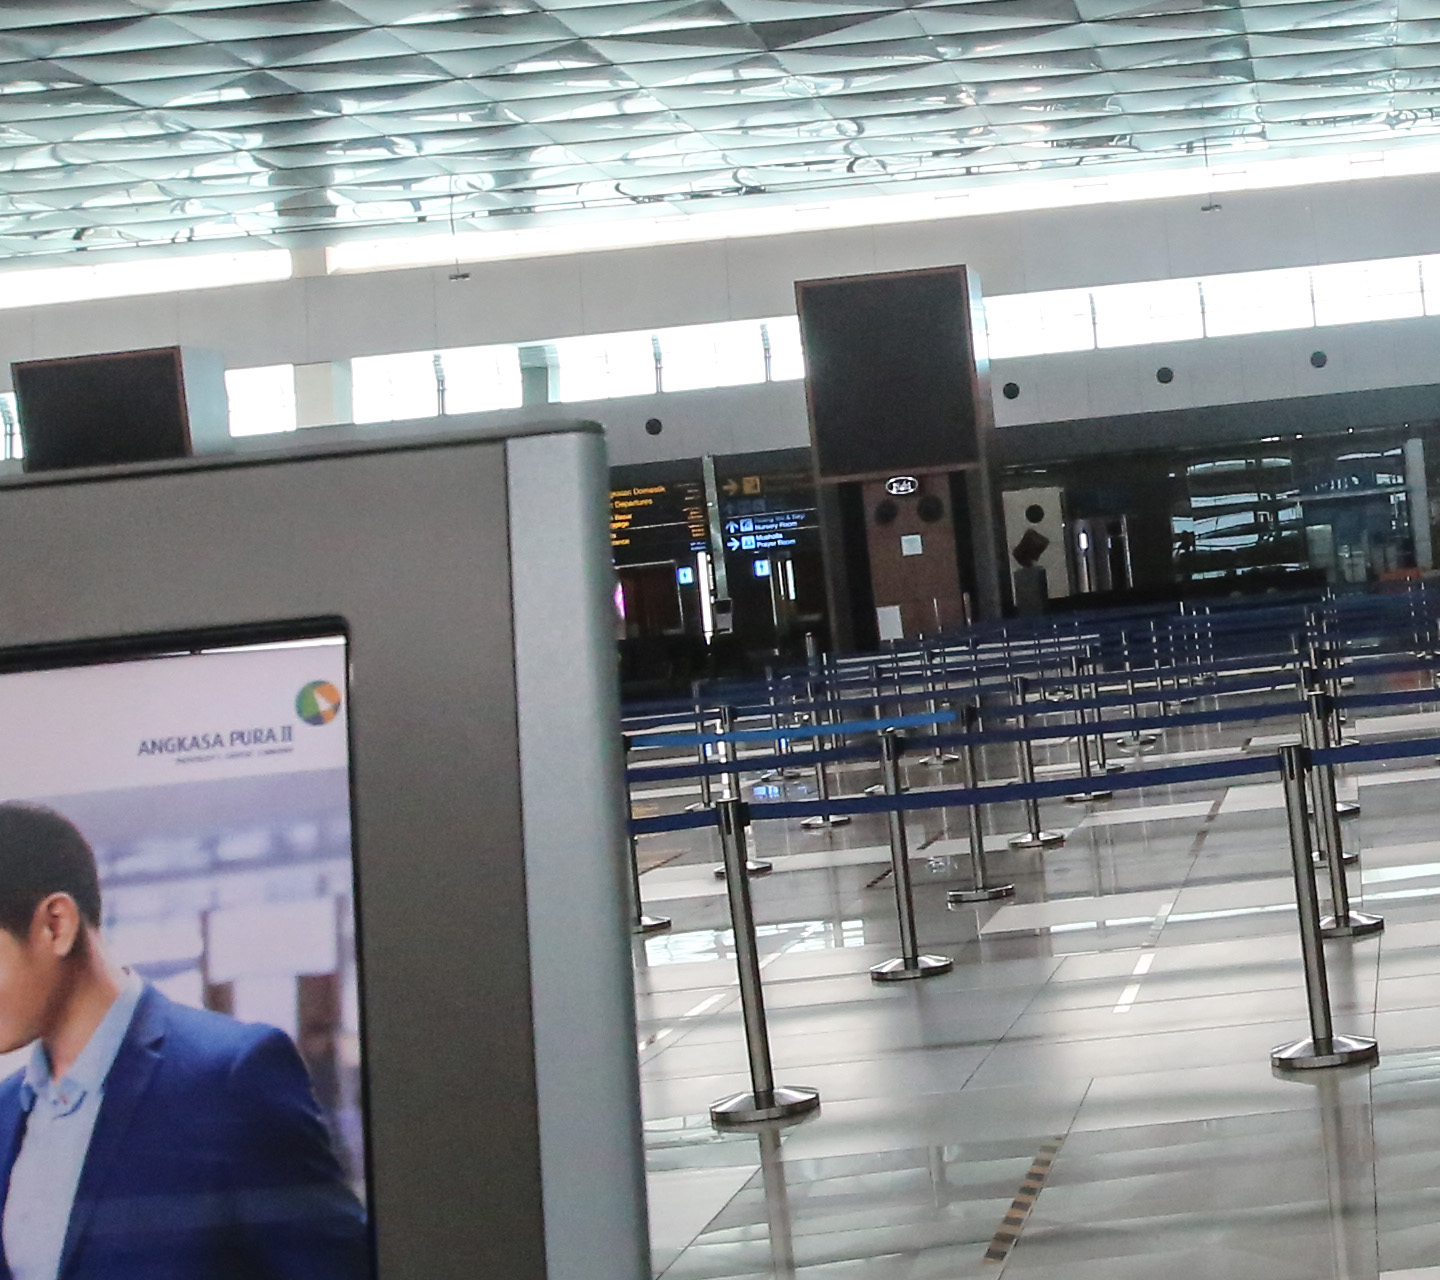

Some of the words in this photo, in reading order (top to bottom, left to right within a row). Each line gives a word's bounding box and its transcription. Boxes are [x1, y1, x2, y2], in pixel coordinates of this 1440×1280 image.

[137, 732, 223, 758] ANGKASA
[229, 729, 277, 748] PURA
[279, 725, 294, 743] II
